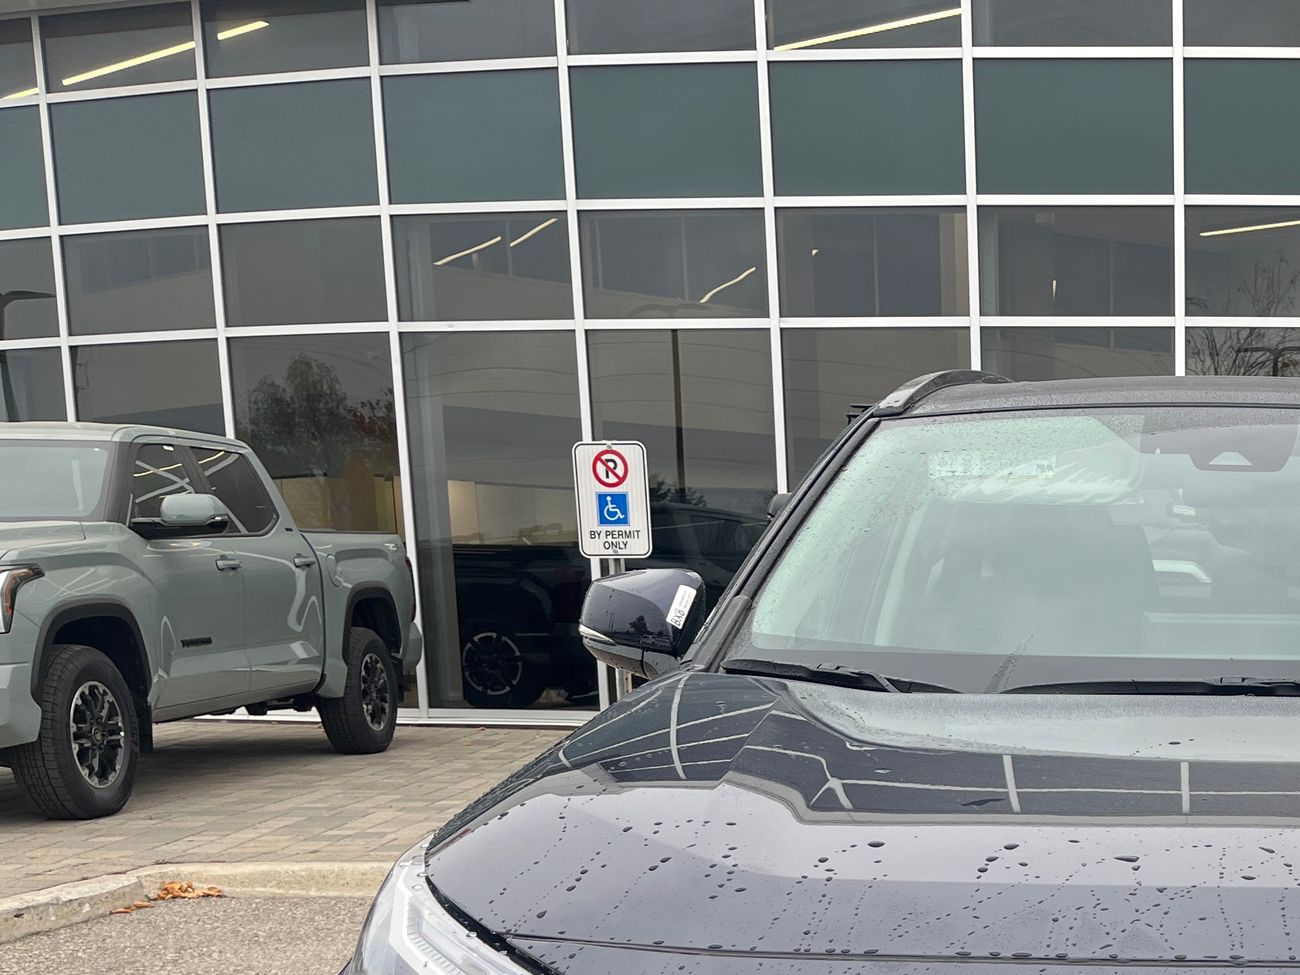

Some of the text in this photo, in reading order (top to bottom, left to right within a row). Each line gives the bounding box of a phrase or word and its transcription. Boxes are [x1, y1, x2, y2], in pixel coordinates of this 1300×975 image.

[589, 529, 641, 540] BY PERMIT
[603, 540, 629, 550] ONLY
